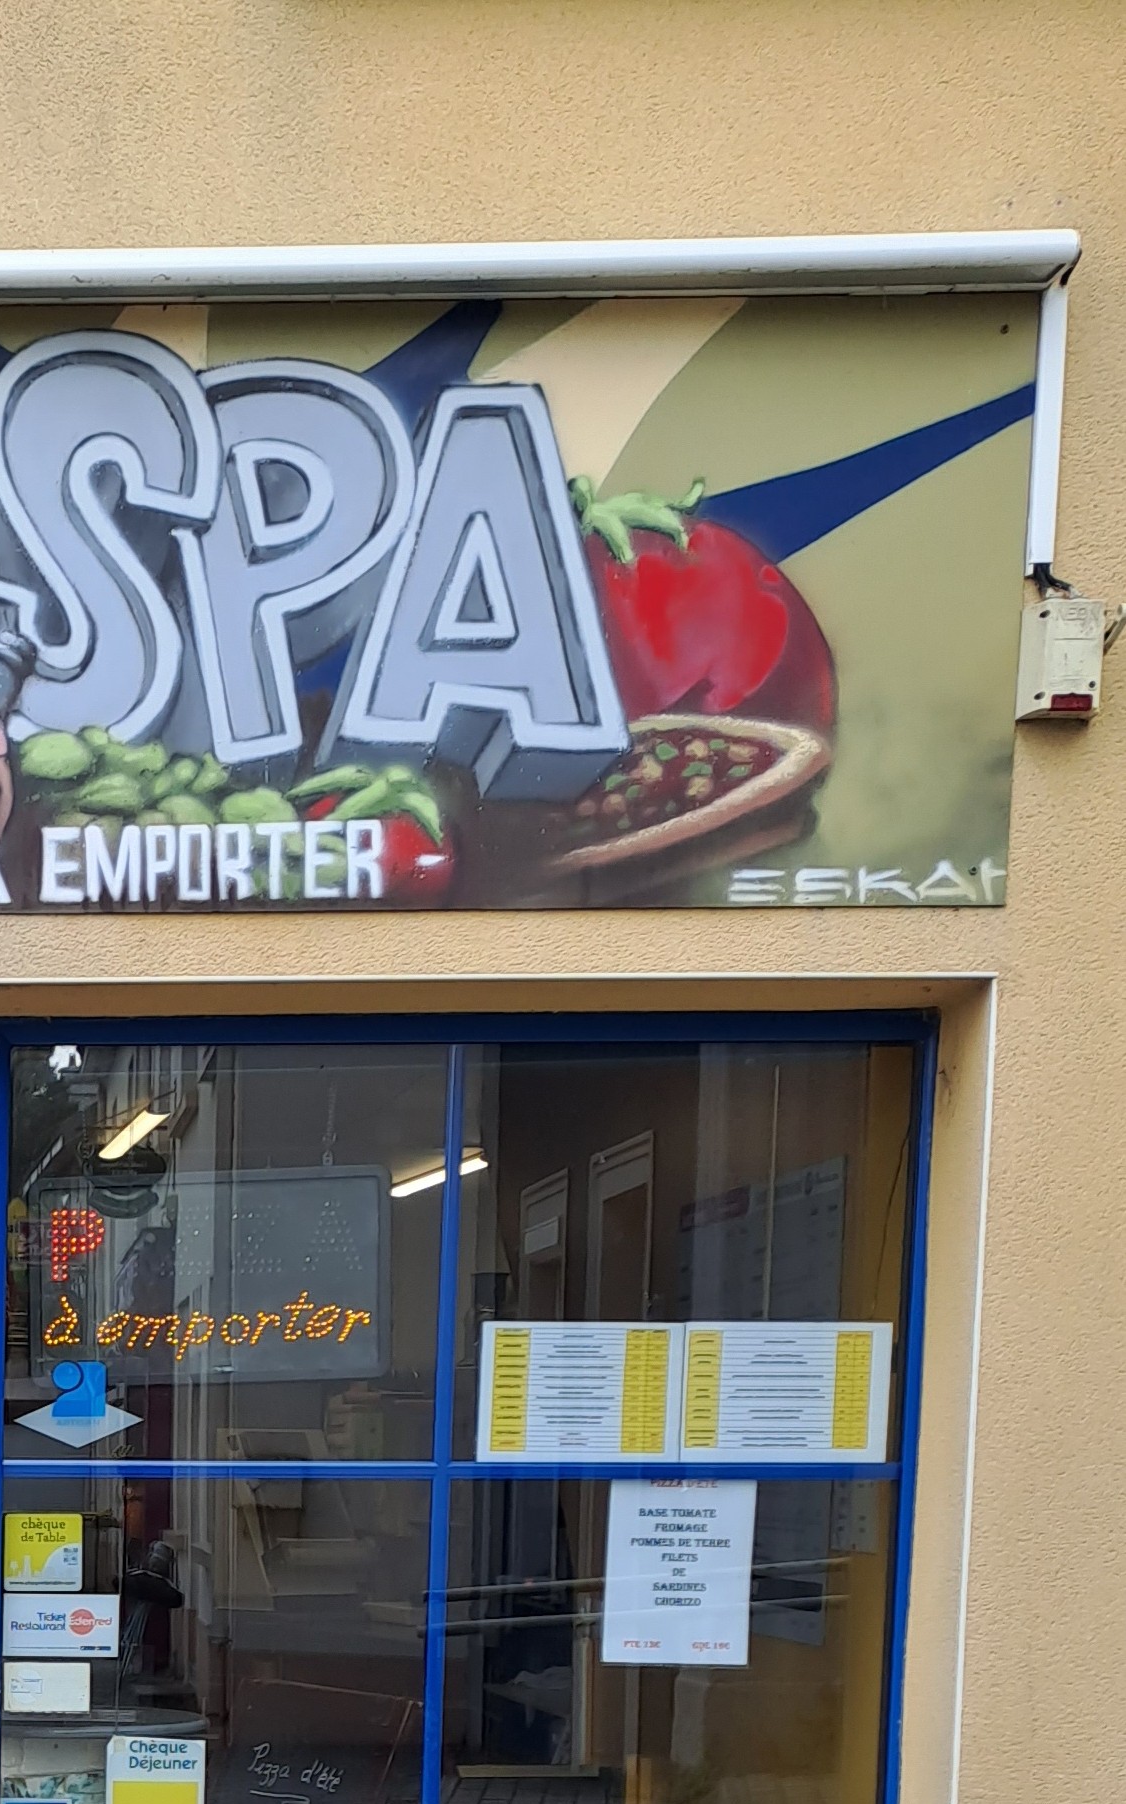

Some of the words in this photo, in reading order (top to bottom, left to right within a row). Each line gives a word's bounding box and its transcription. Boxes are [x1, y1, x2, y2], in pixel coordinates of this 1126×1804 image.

[39, 820, 384, 903] EMPORTER
[96, 1289, 371, 1361] emporter
[638, 1508, 668, 1517] BASE
[671, 1508, 717, 1518] TOMATE
[654, 1523, 708, 1532] FROMAGE
[21, 1532, 34, 1542] de
[36, 1532, 66, 1542] Table
[630, 1538, 675, 1547] POMMES
[678, 1538, 692, 1547] DE
[661, 1553, 699, 1562] FILETS
[672, 1568, 687, 1577] DE
[129, 1740, 188, 1755] Chèque
[128, 1755, 198, 1772] Déjeuner
